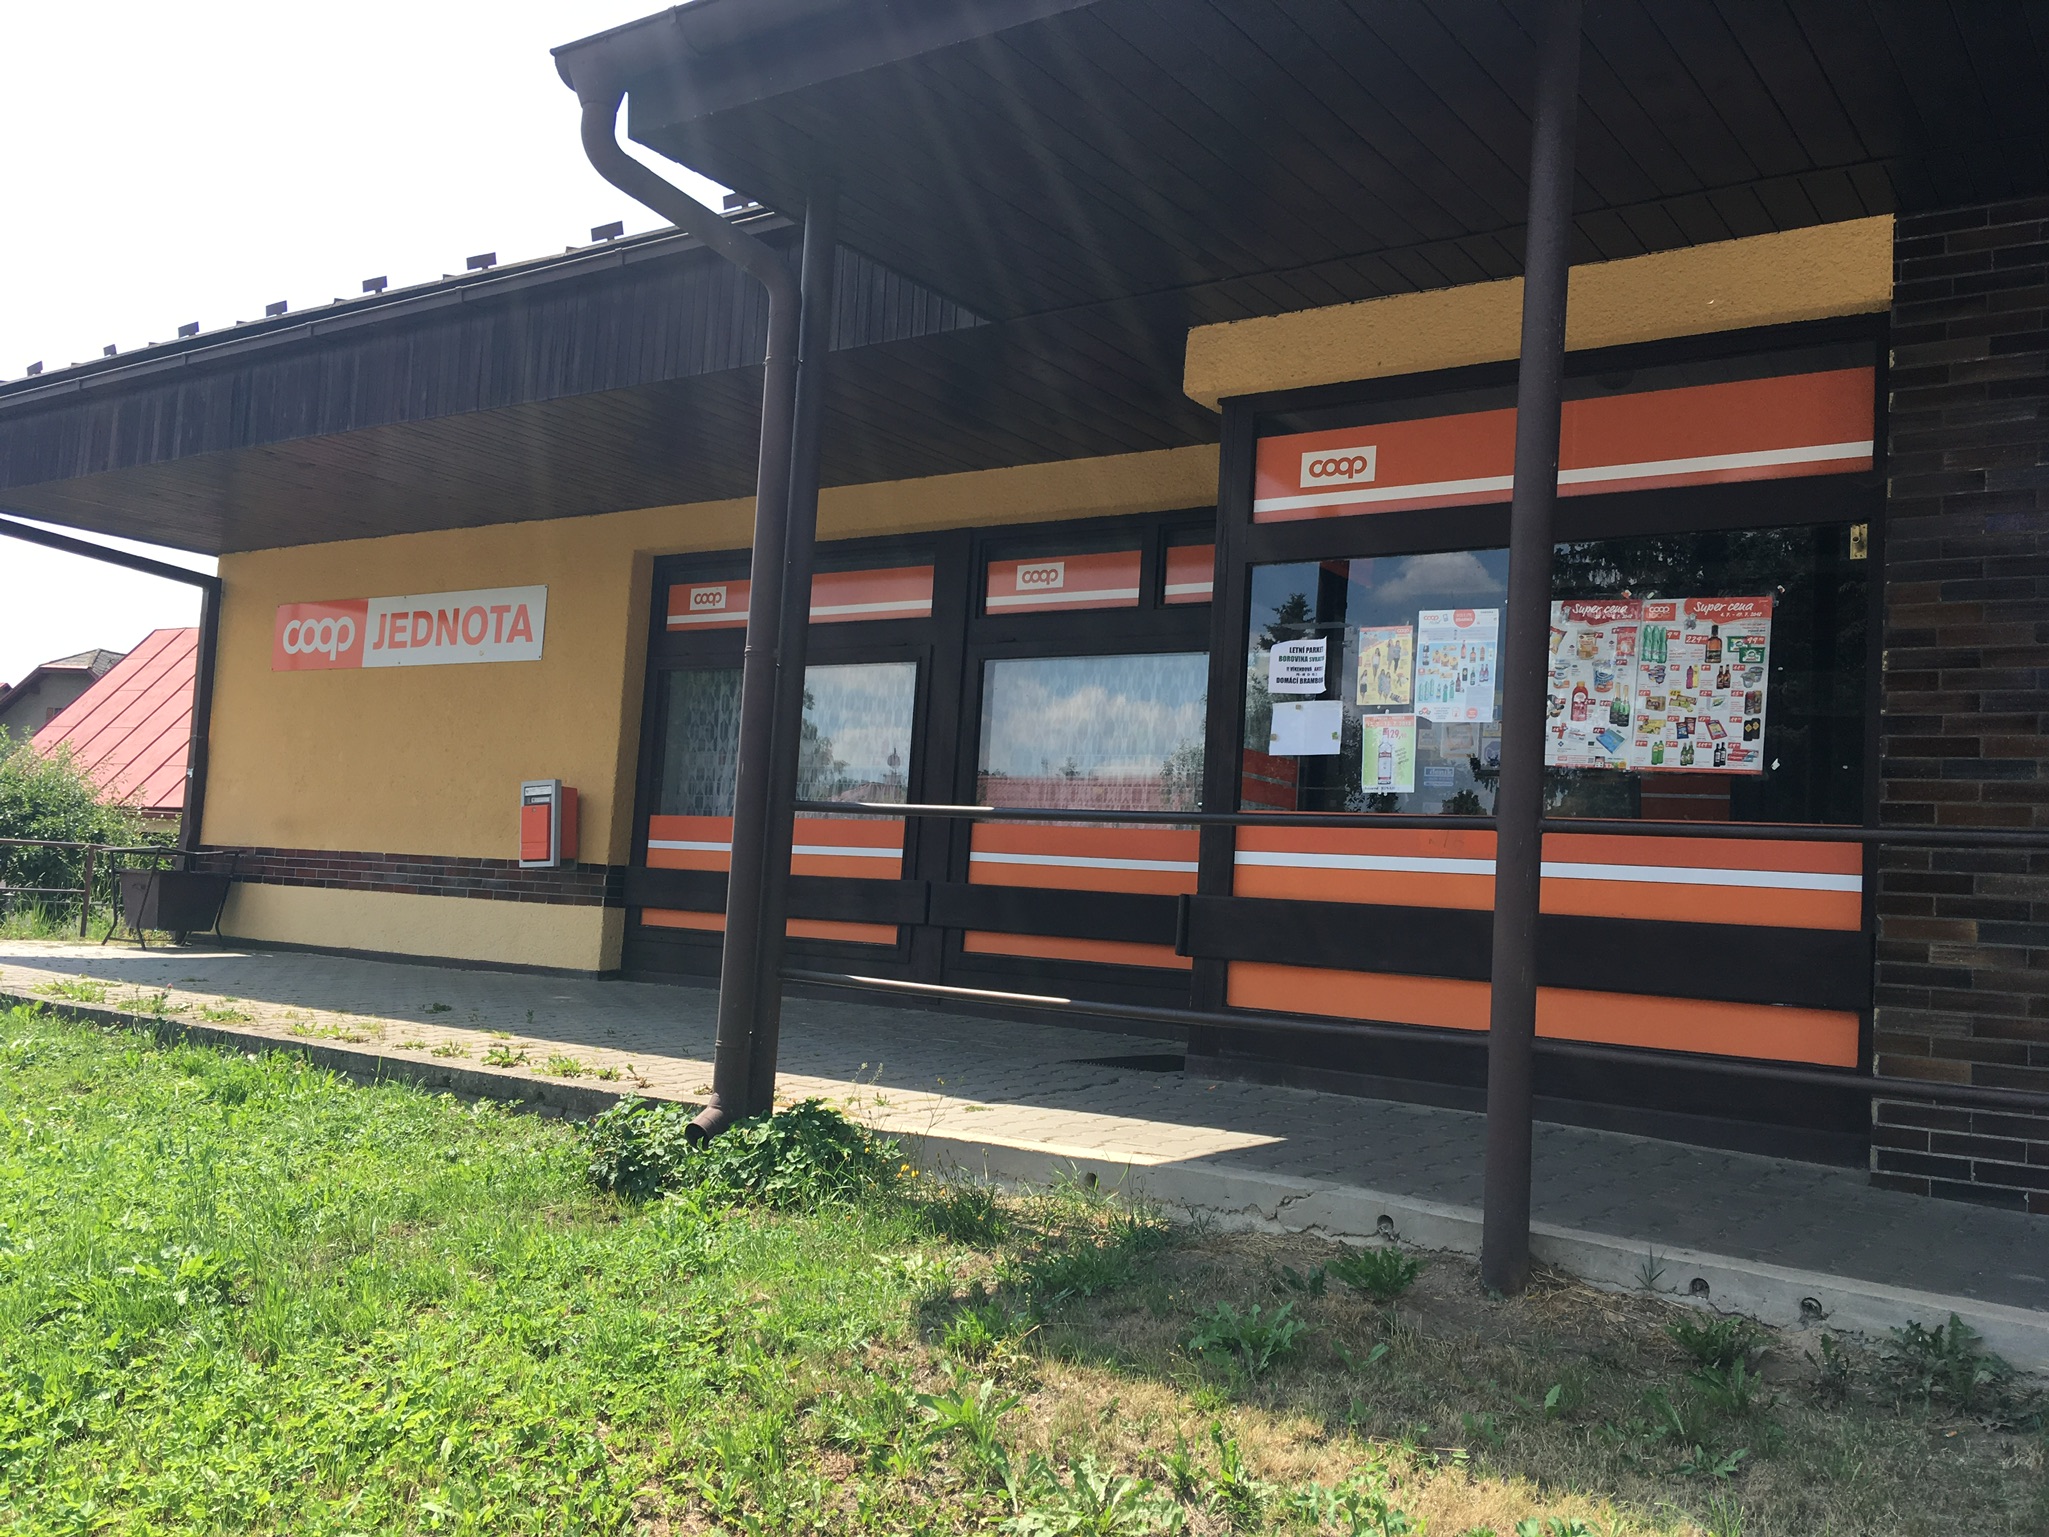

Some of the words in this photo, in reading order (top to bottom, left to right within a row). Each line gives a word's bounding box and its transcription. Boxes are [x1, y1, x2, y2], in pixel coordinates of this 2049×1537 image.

[1308, 455, 1368, 480] coop
[1022, 568, 1059, 586] coop
[694, 592, 723, 606] coop
[1572, 603, 1603, 617] Super
[1649, 606, 1670, 614] coop
[1693, 601, 1726, 615] Super
[1727, 602, 1755, 612] cena
[283, 616, 356, 661] coop
[372, 603, 534, 651] JEDNOTA
[1276, 676, 1299, 684] DOMÁCÍ
